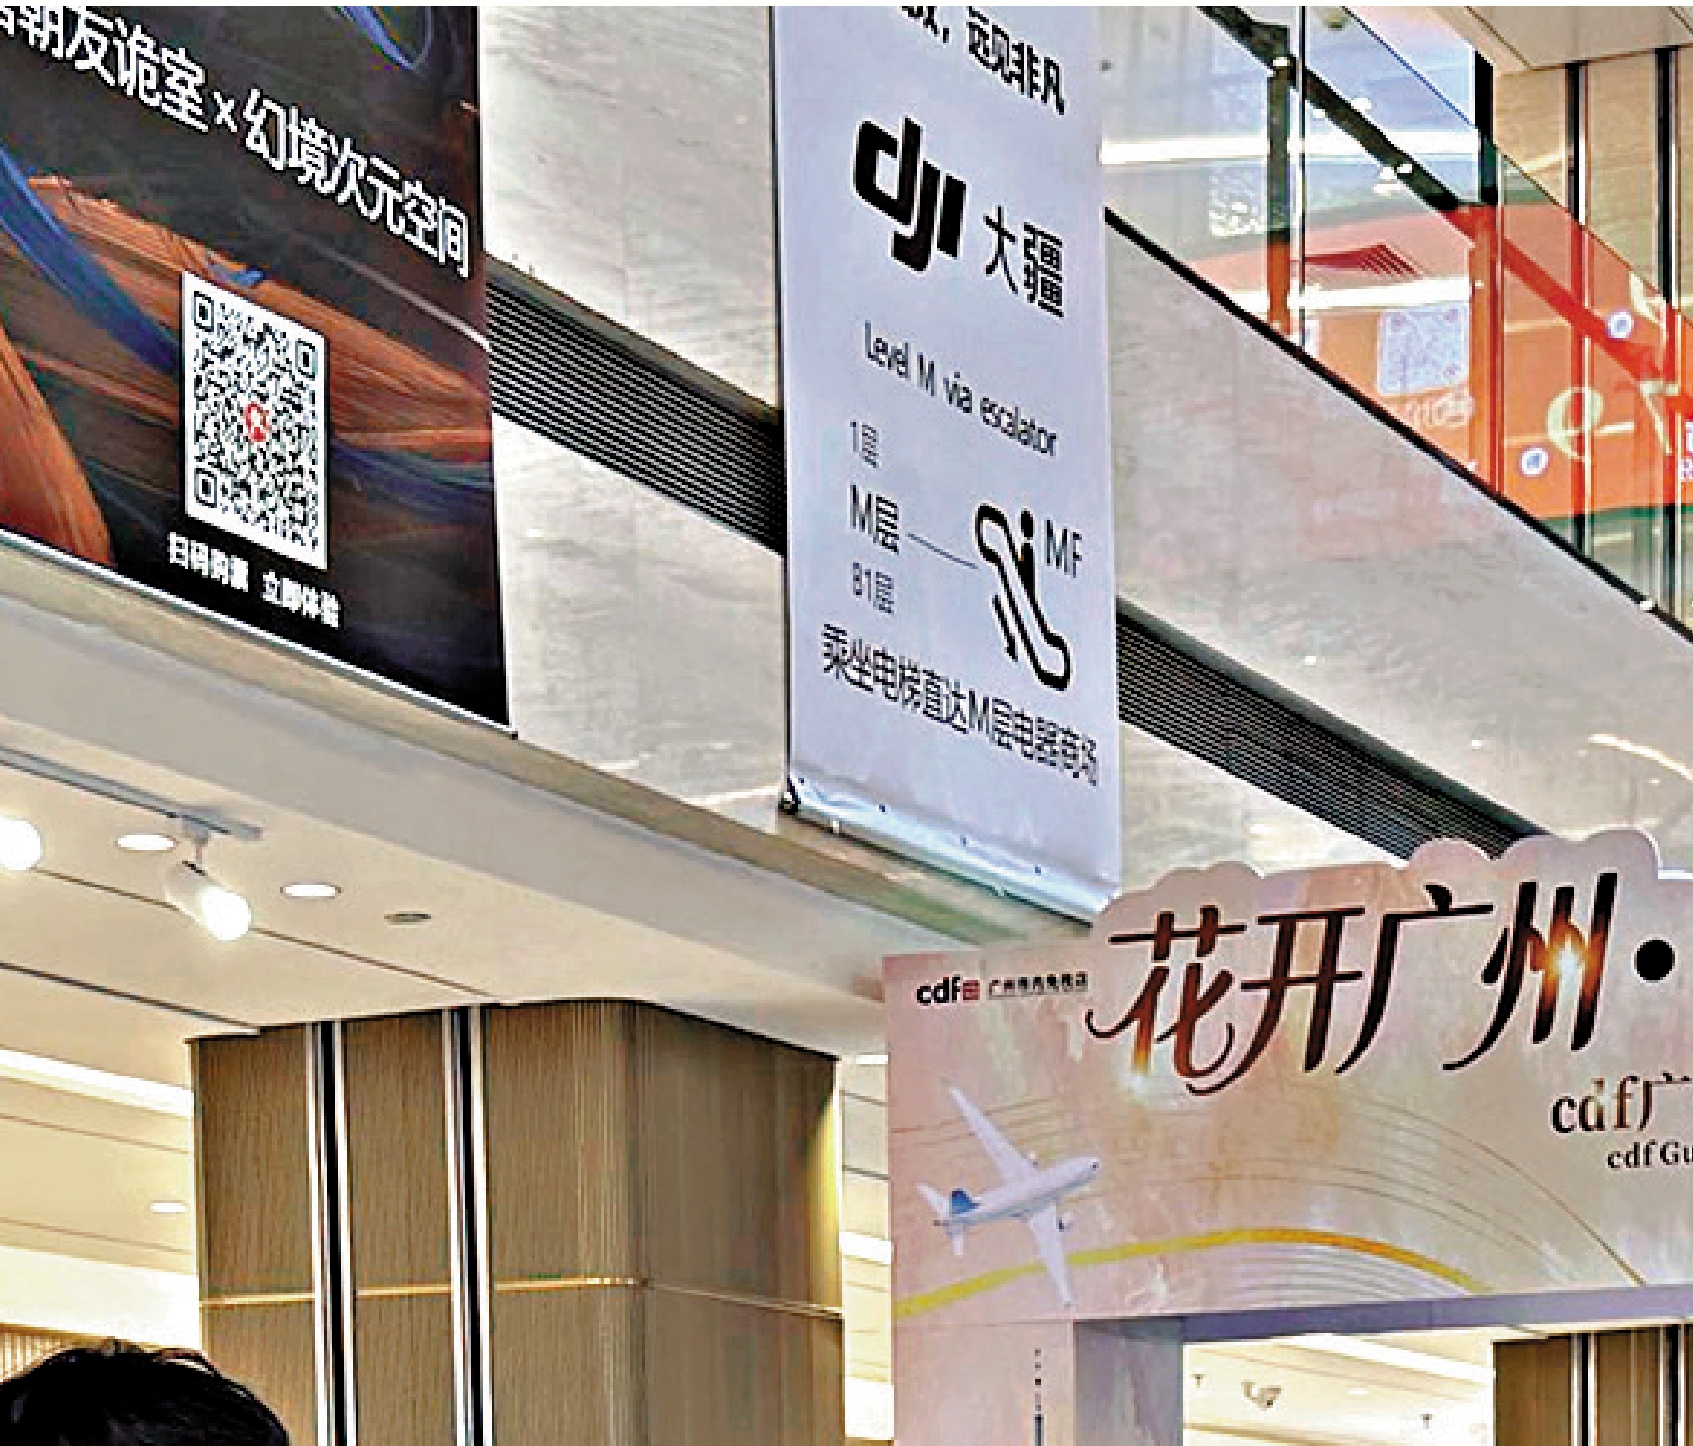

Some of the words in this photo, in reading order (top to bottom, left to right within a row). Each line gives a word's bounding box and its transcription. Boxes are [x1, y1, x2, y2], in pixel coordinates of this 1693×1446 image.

[984, 205, 1065, 318] 大疆
[864, 320, 910, 380] Level
[917, 352, 936, 397] M
[942, 371, 973, 414] via
[980, 397, 1058, 456] escalator
[849, 484, 900, 555] M层
[1044, 519, 1083, 579] MF
[916, 974, 962, 1004] cdf
[1607, 1140, 1656, 1169] cdf
